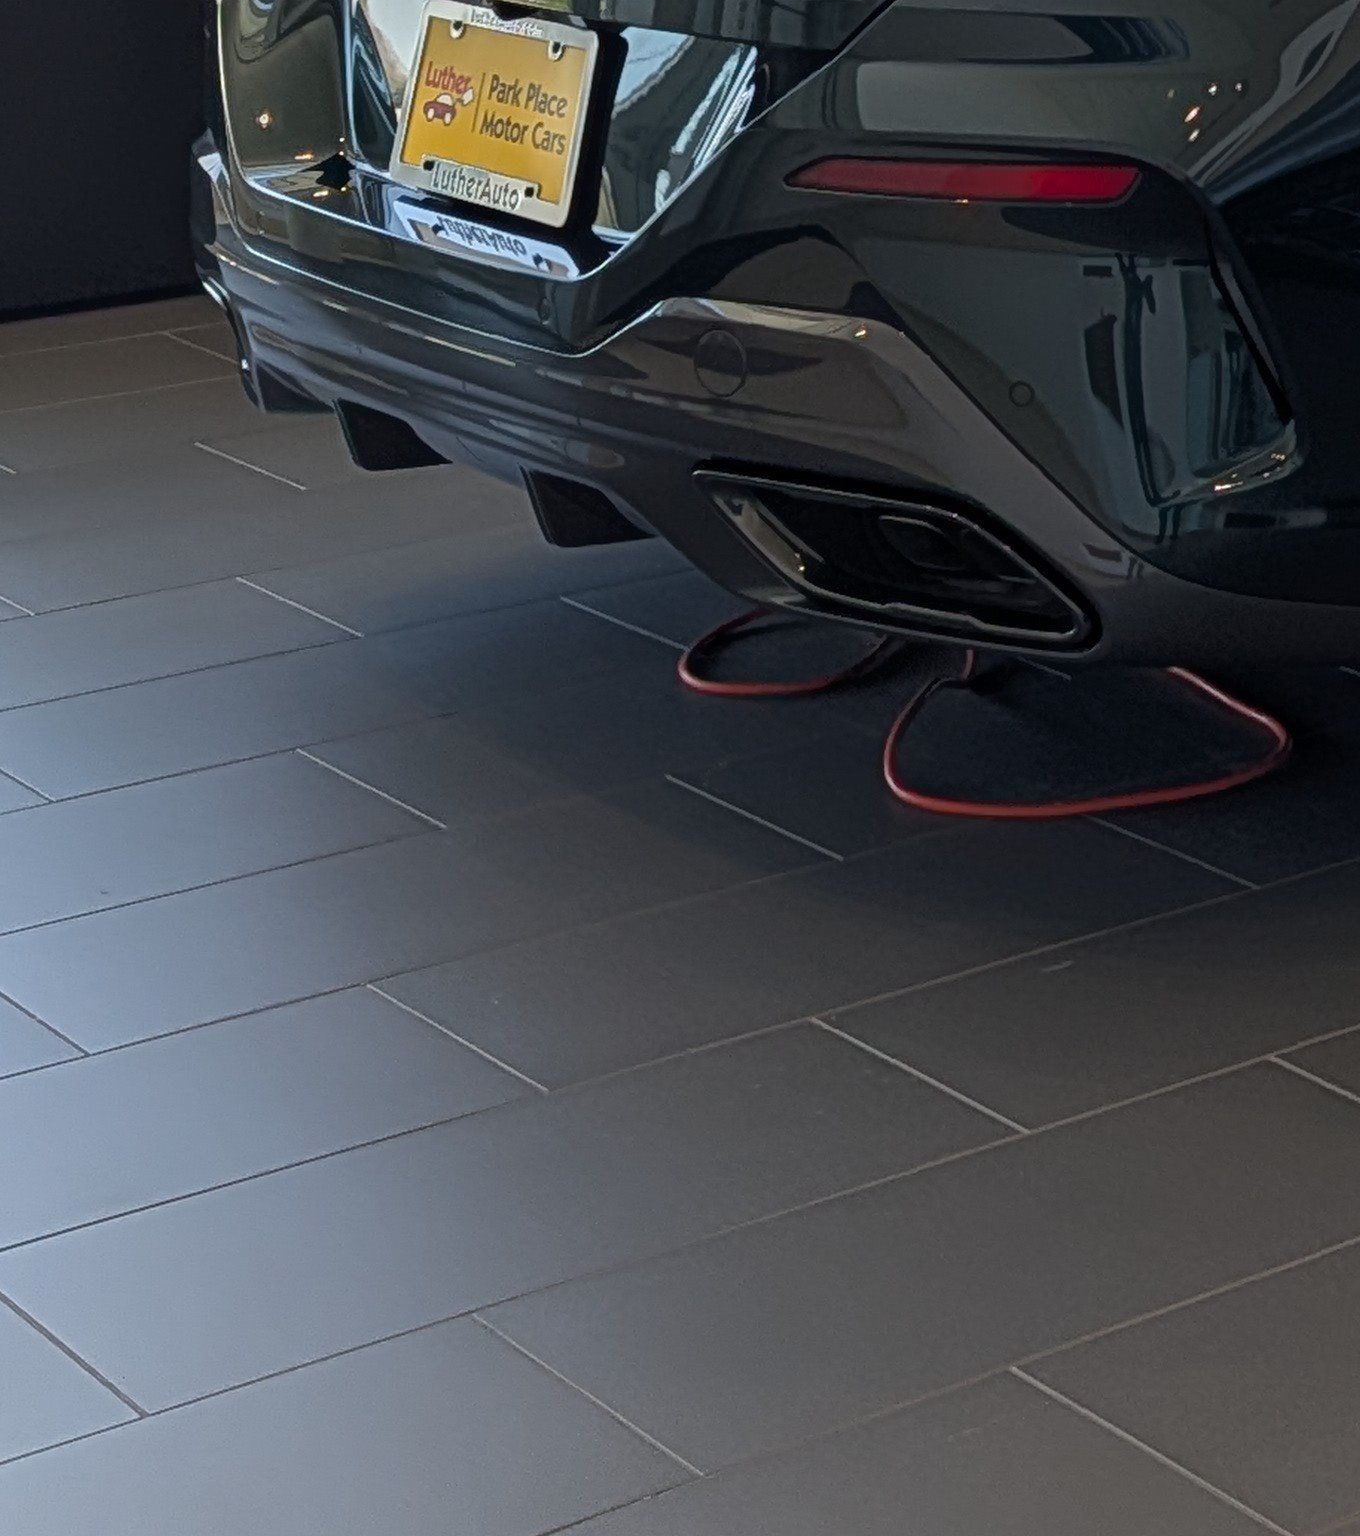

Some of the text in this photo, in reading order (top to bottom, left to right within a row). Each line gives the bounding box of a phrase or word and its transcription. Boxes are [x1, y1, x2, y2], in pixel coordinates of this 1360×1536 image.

[425, 61, 473, 95] Luther
[488, 75, 568, 119] Park Place
[480, 109, 567, 156] Motor Cars
[431, 162, 520, 211] LutherAuto
